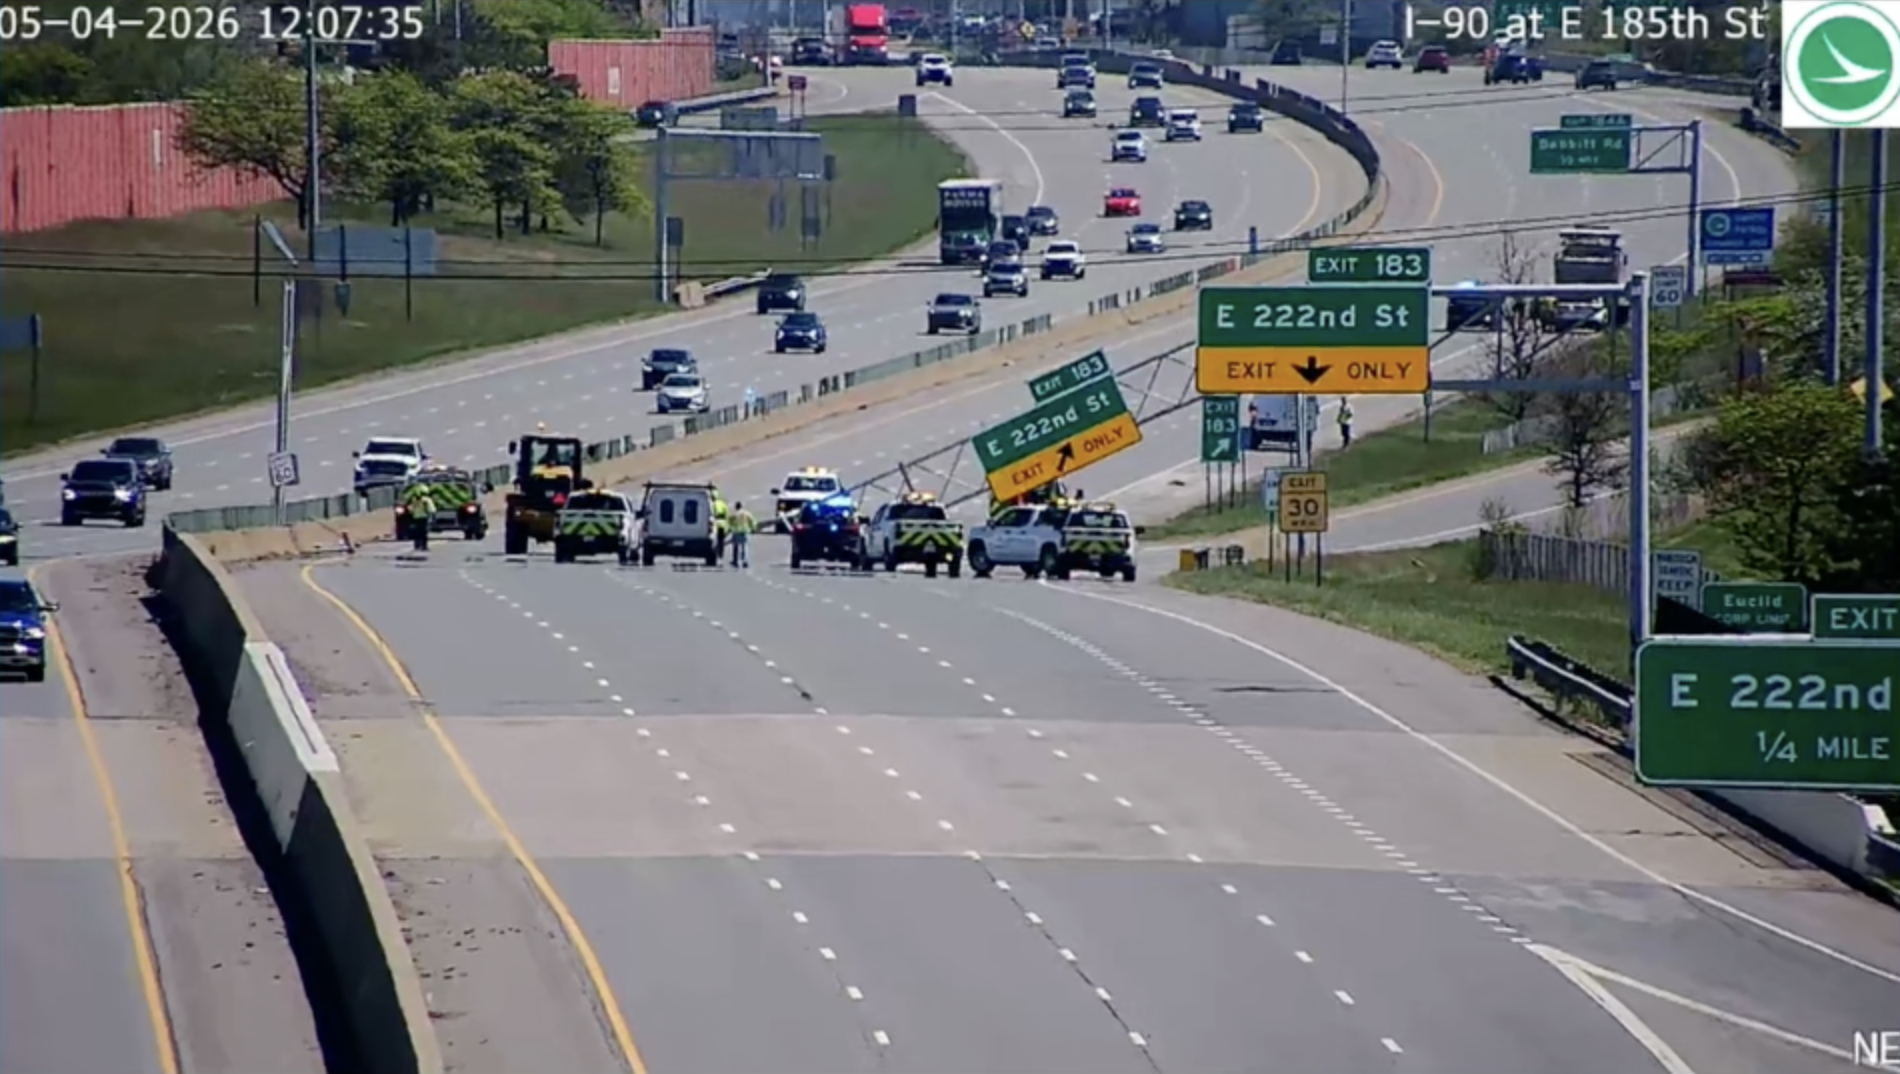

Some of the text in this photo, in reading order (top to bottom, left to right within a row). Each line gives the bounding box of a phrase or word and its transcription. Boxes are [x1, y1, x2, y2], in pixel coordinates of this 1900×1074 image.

[1315, 254, 1423, 276] EXIT 183
[1655, 289, 1679, 303] 60
[1217, 304, 1410, 328] E 222nd St
[1034, 354, 1104, 397] EXIT 183
[1227, 361, 1412, 380] EXIT ONLY
[1206, 402, 1235, 413] EXIT
[987, 391, 1111, 457] E 222nd St
[1206, 419, 1235, 433] 183
[1011, 425, 1124, 486] EXIT ONLY
[1288, 498, 1319, 517] 30
[1723, 594, 1782, 608] Euclid
[1830, 607, 1897, 630] EXIT
[1671, 673, 1892, 710] E 222nd
[1817, 737, 1890, 760] MILE
